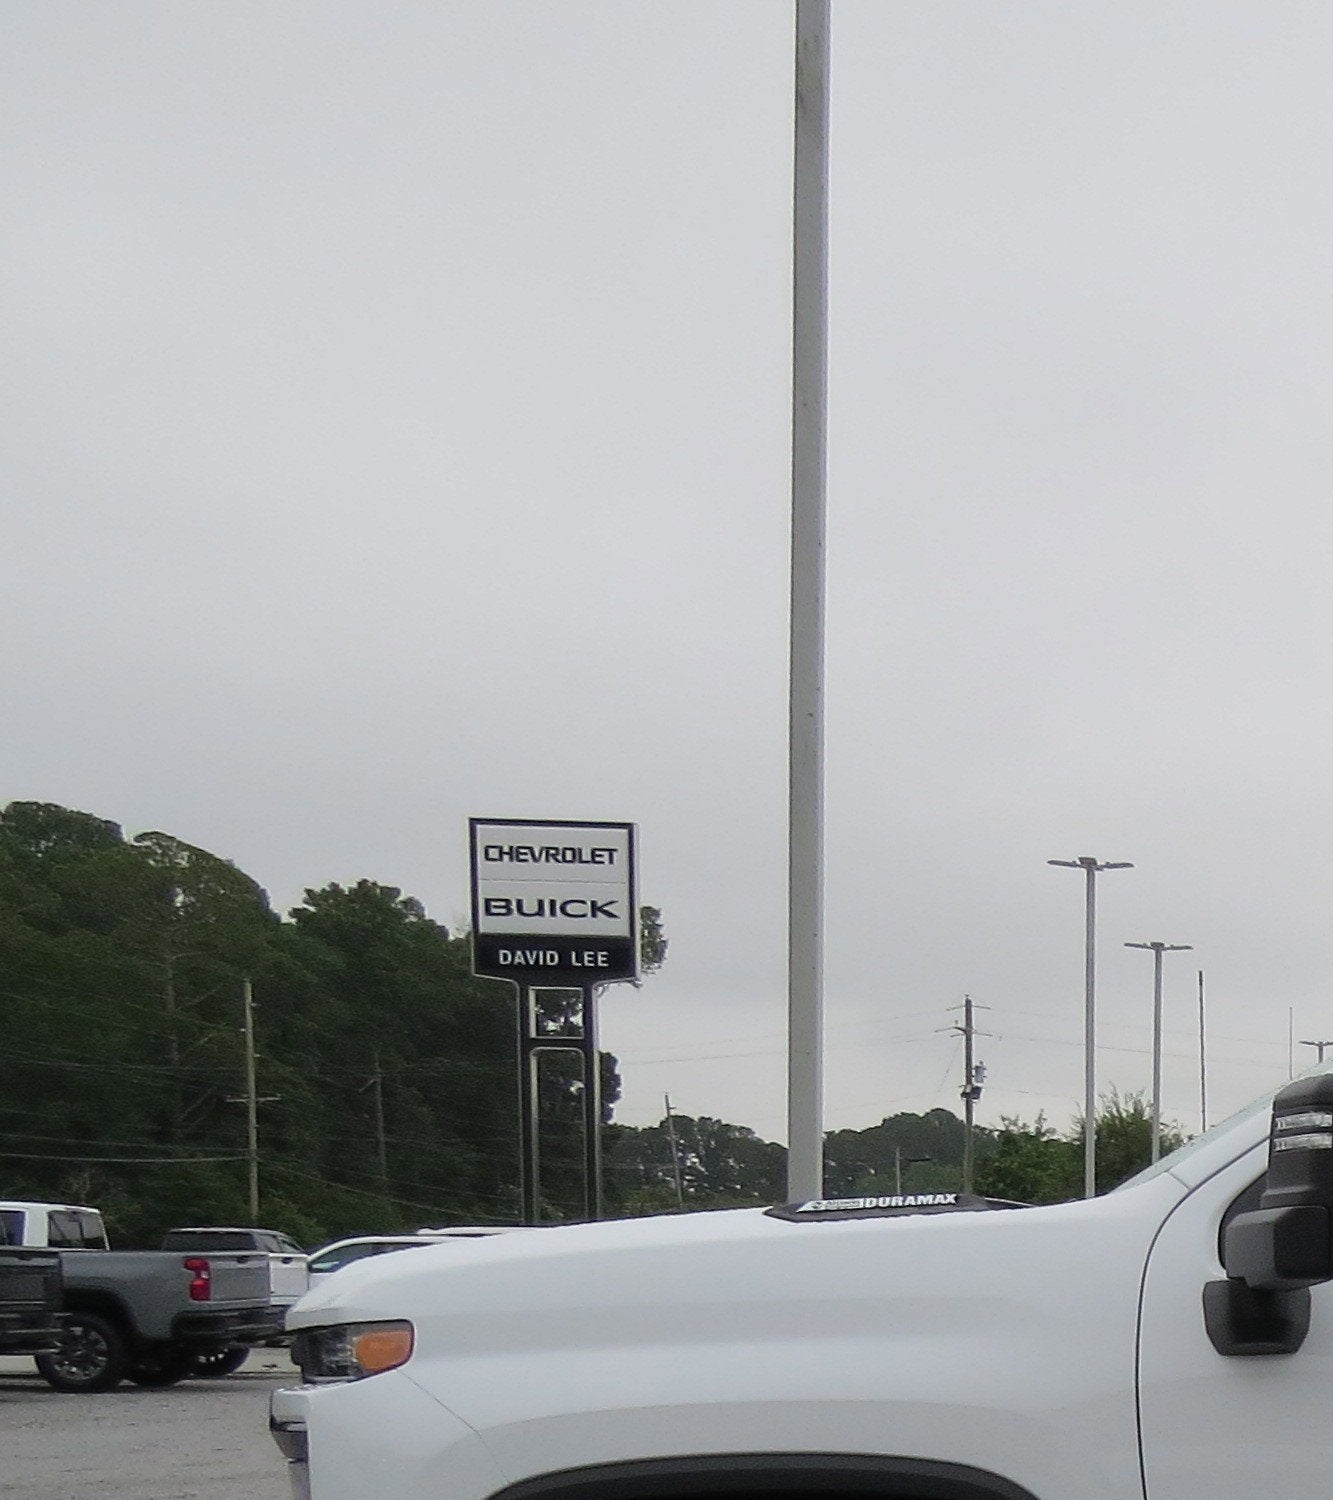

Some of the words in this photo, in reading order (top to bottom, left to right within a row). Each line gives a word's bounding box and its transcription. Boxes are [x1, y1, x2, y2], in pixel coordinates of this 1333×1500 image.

[484, 845, 618, 865] CHEVROLET
[484, 898, 621, 919] BUICK
[499, 950, 560, 967] DAVID
[571, 951, 610, 968] LEE
[866, 1193, 958, 1208] DURAMAX
